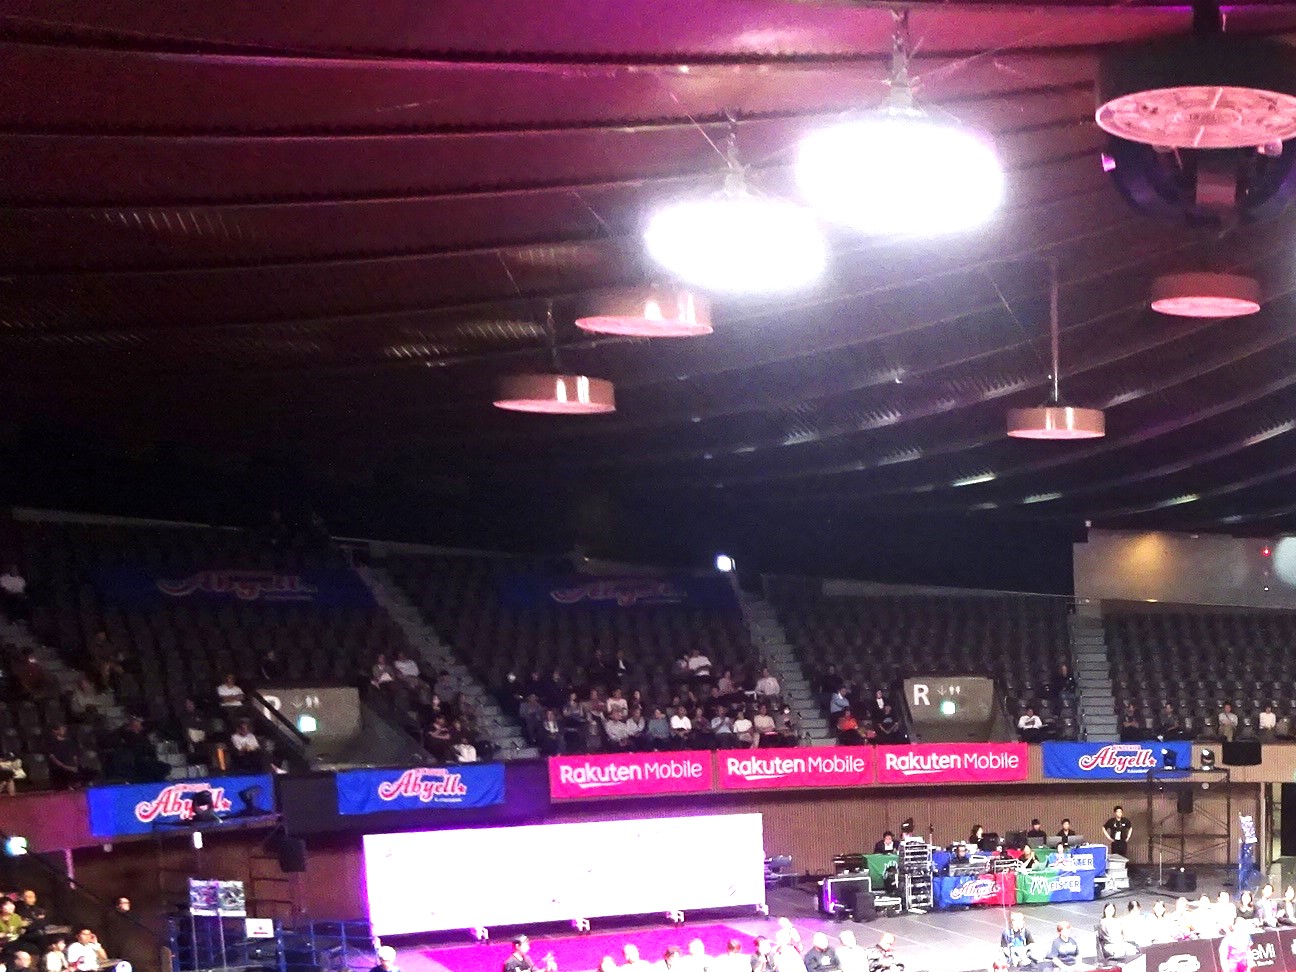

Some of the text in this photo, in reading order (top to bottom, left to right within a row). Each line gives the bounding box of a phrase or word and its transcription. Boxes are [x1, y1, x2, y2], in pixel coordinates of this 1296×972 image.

[913, 684, 931, 706] R
[727, 755, 864, 777] Rakuten Mobile
[886, 752, 1019, 771] Rakuten Mobile
[1079, 746, 1150, 773] Abyell
[560, 760, 703, 785] Rakuten Mobile
[378, 772, 462, 802] Abyell
